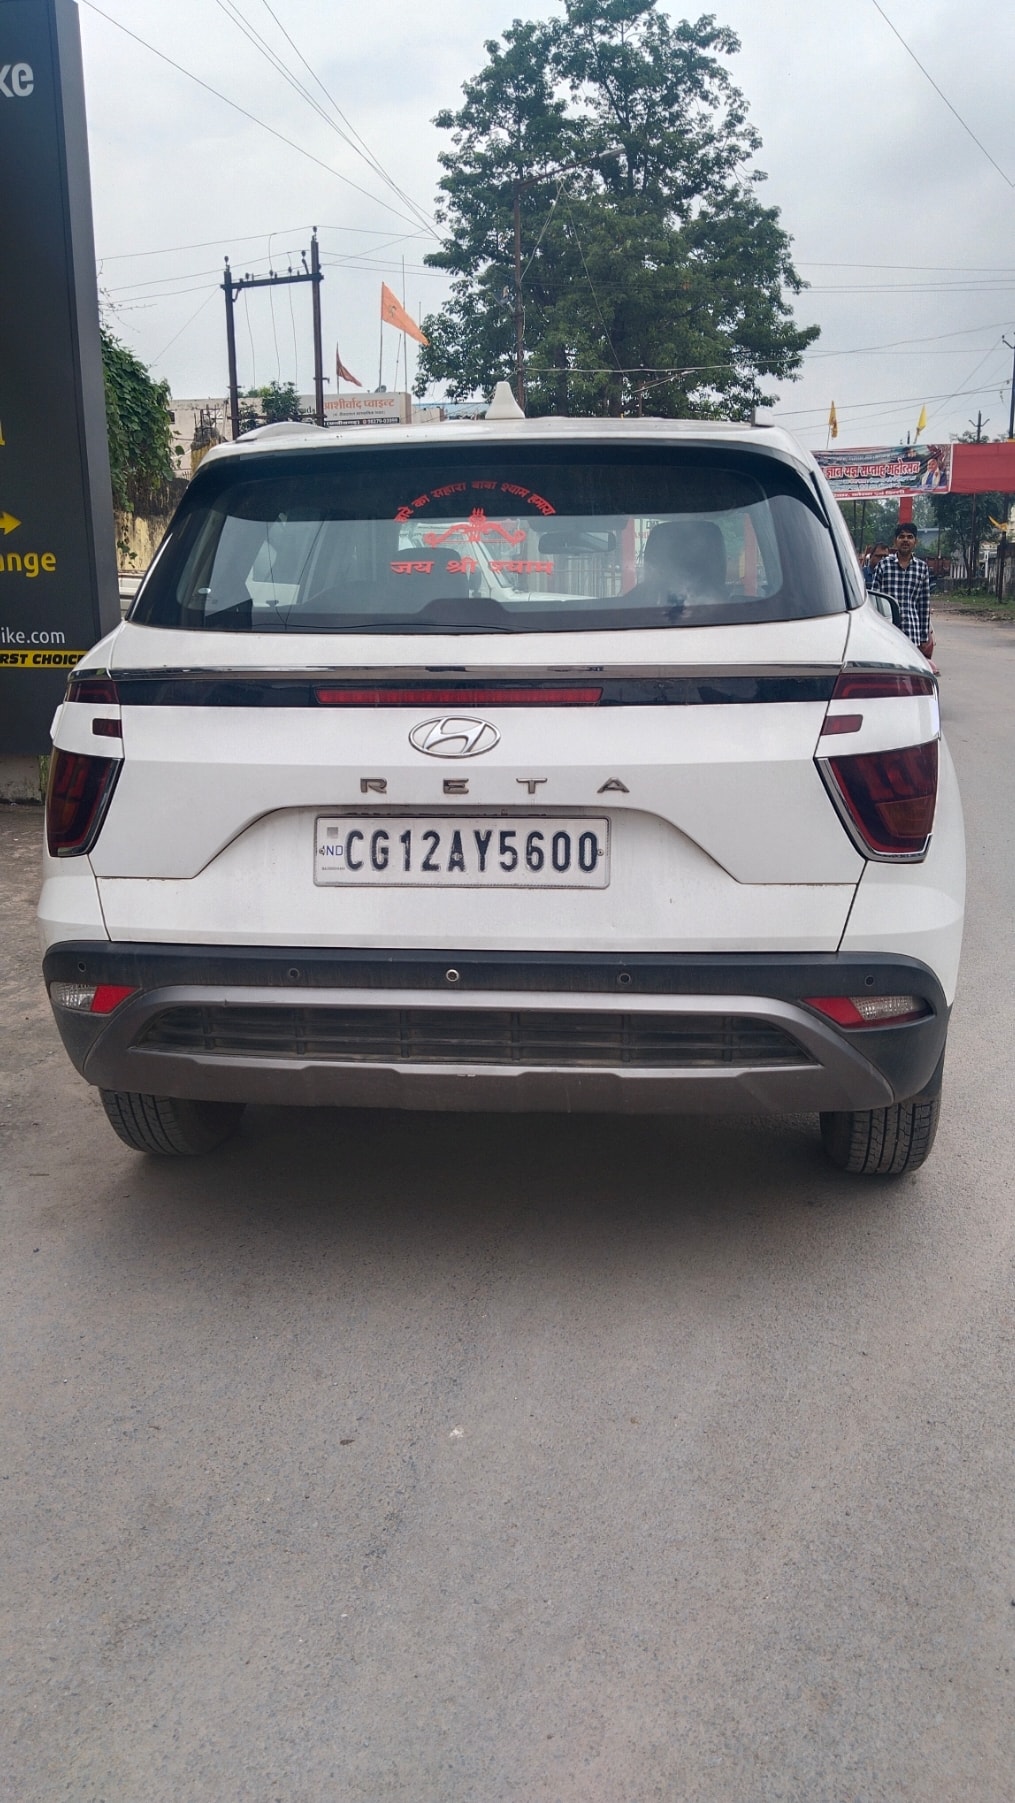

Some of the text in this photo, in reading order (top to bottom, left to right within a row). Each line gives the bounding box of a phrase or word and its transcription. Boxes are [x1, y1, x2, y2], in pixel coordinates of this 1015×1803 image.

[411, 494, 430, 508] का
[431, 482, 467, 498] सहारा
[471, 480, 498, 490] बाबा
[501, 482, 530, 499] श्याम
[527, 493, 557, 516] हमारा
[390, 555, 555, 575] जय श्री श्याम
[345, 829, 599, 873] CG12AY5600
